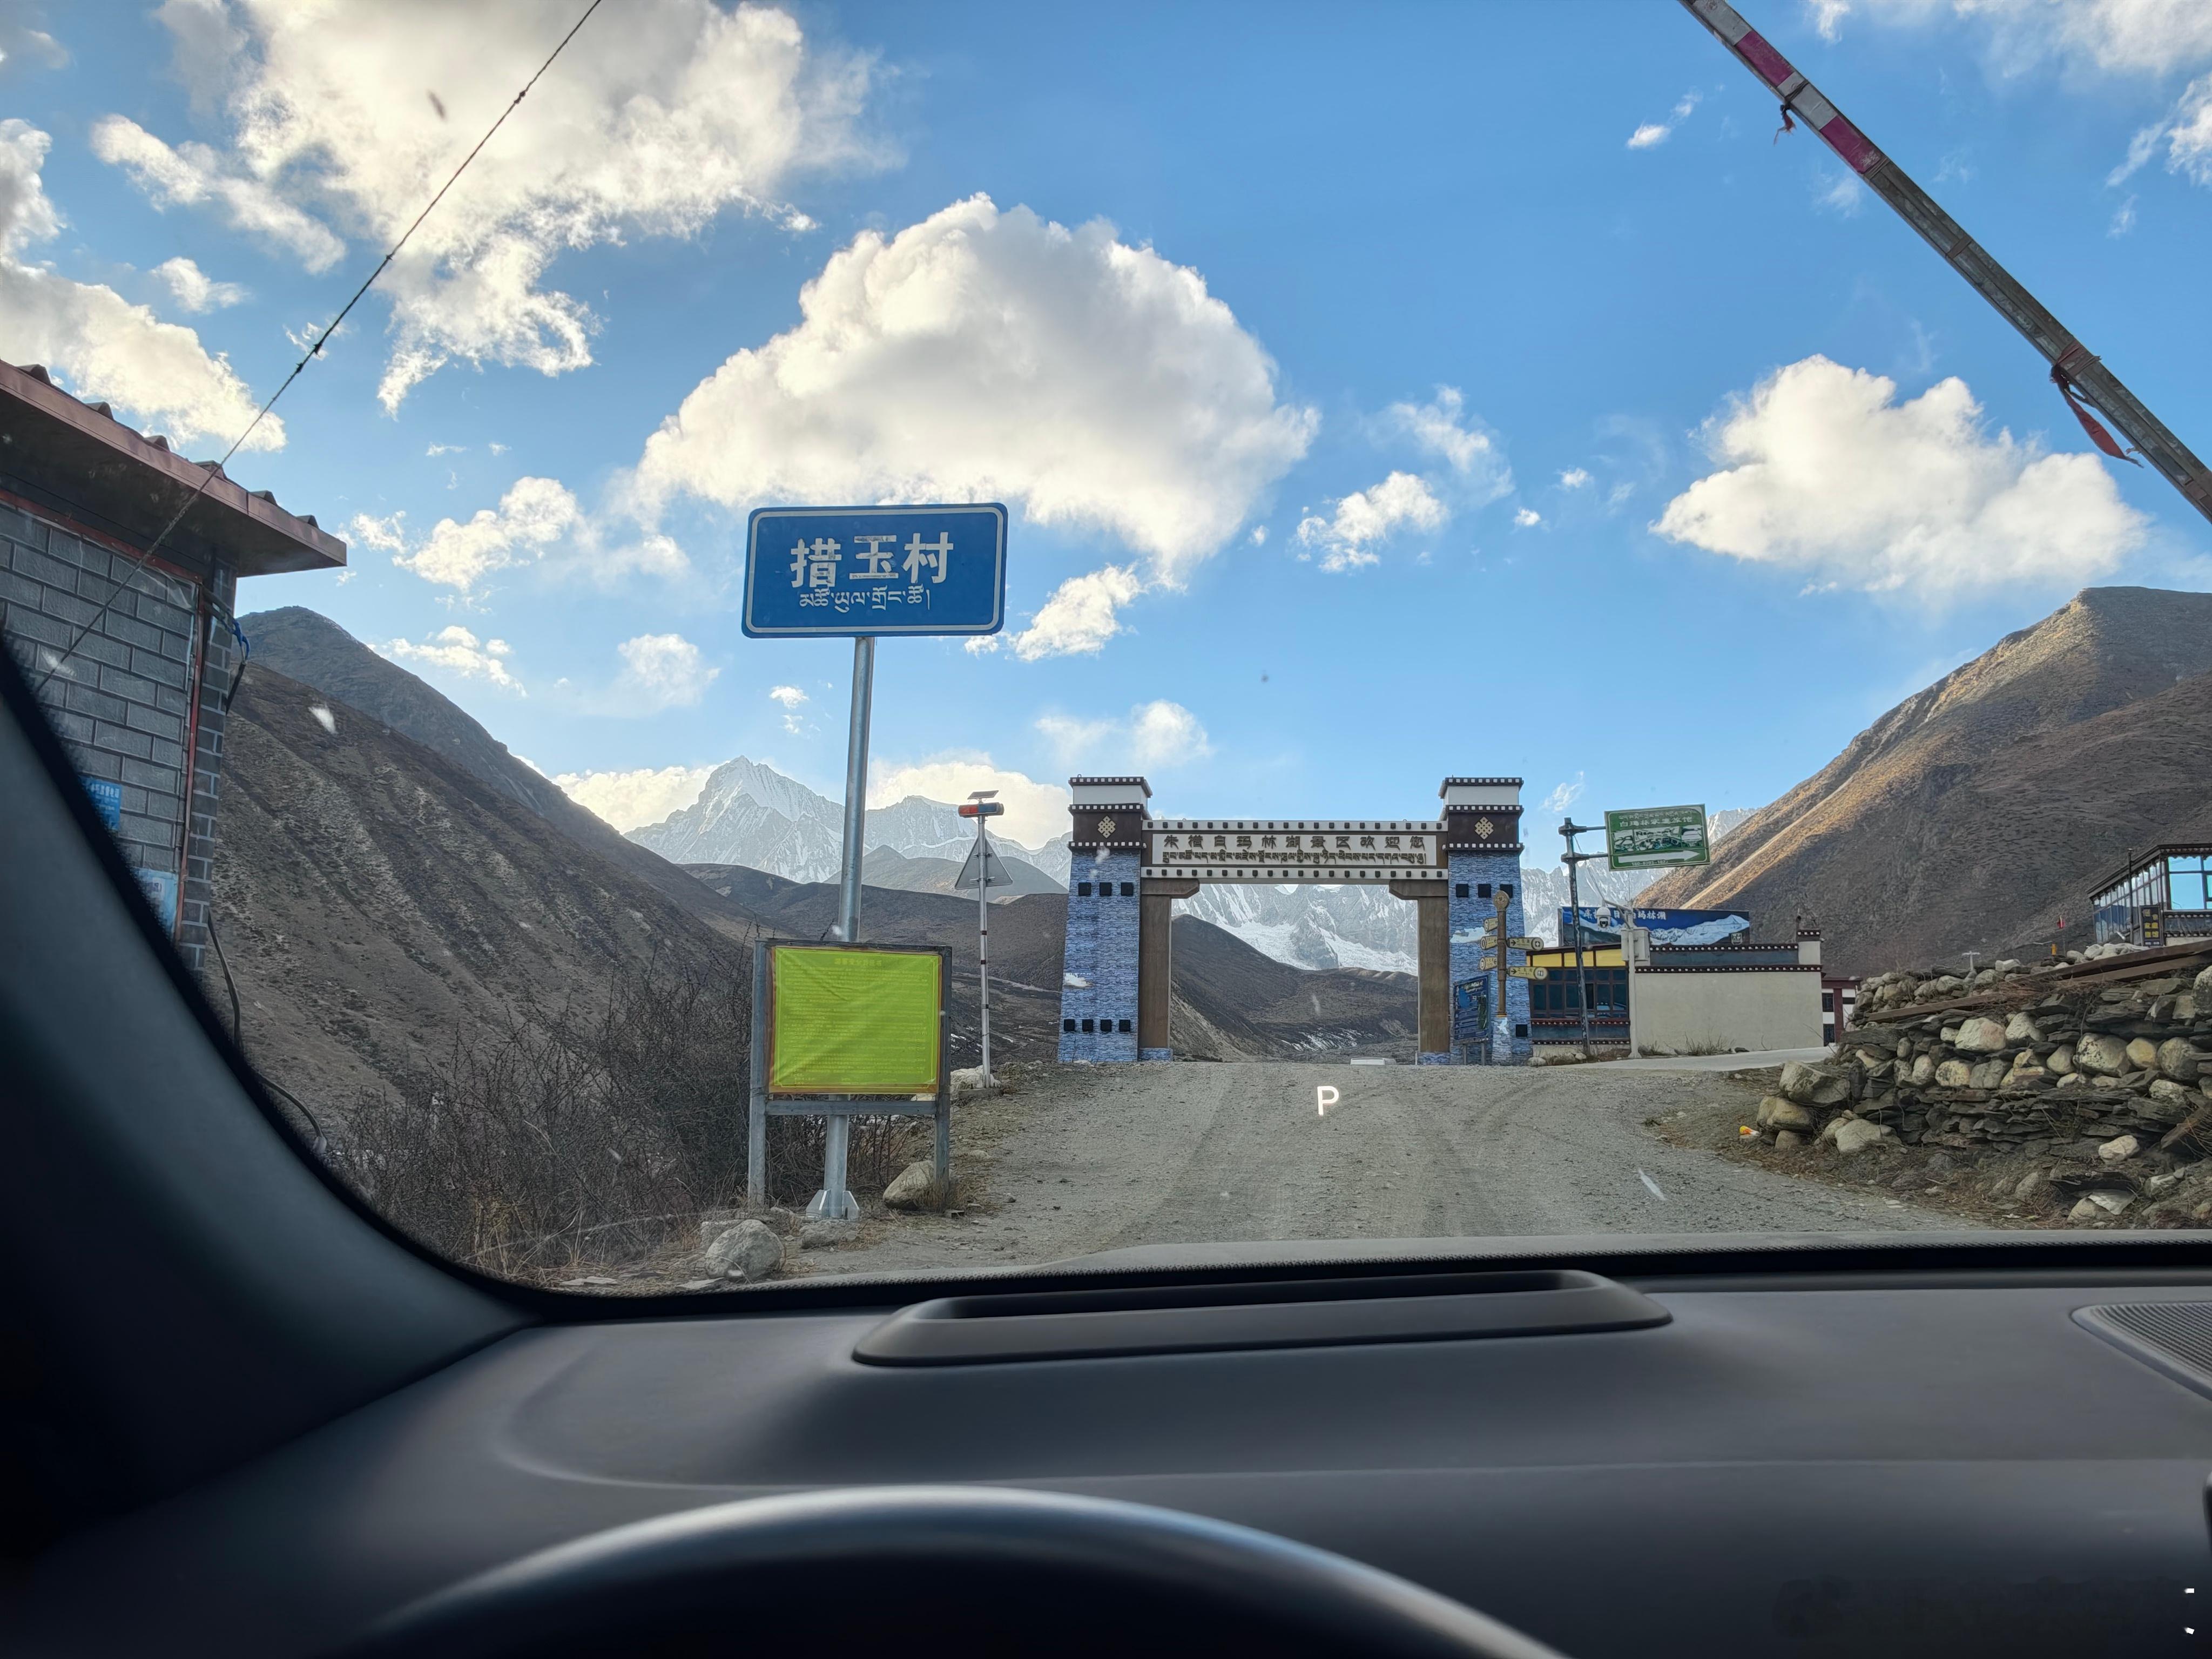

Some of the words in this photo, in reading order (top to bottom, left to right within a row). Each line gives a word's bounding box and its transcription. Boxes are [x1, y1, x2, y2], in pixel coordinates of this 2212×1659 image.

[790, 531, 954, 588] 措玉村
[1317, 1085, 1339, 1116] P
